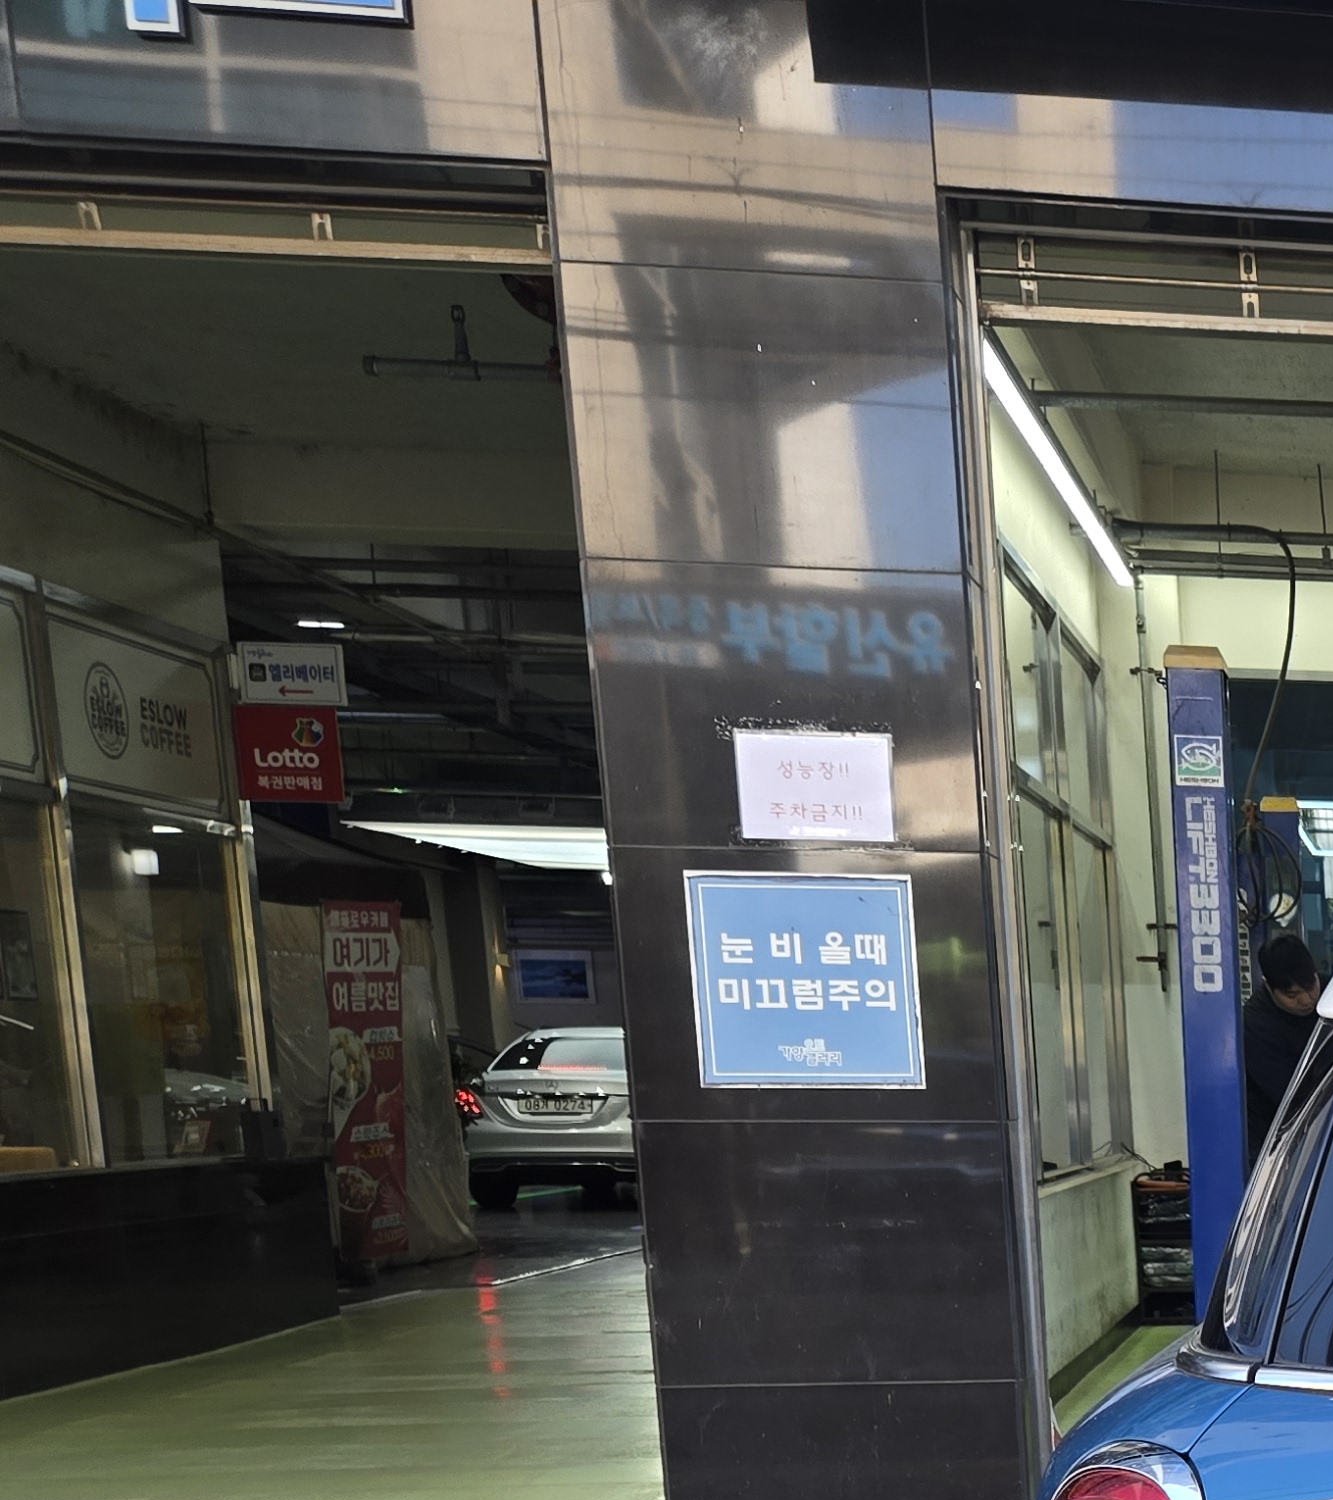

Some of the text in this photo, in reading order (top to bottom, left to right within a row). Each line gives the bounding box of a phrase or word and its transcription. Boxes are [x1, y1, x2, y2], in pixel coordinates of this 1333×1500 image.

[139, 697, 188, 731] ESLOW
[140, 723, 192, 758] COFFEE
[254, 748, 320, 769] Lotto
[777, 759, 850, 780] 성능장!!
[257, 775, 323, 791] 복권판매점
[769, 802, 863, 823] 주차금지!!
[1203, 797, 1219, 883] HESHBON
[333, 937, 391, 968] 여기가
[720, 931, 888, 966] 눈 비 올때
[718, 978, 897, 1012] 미끄럼주의
[554, 1099, 586, 1111] 0274
